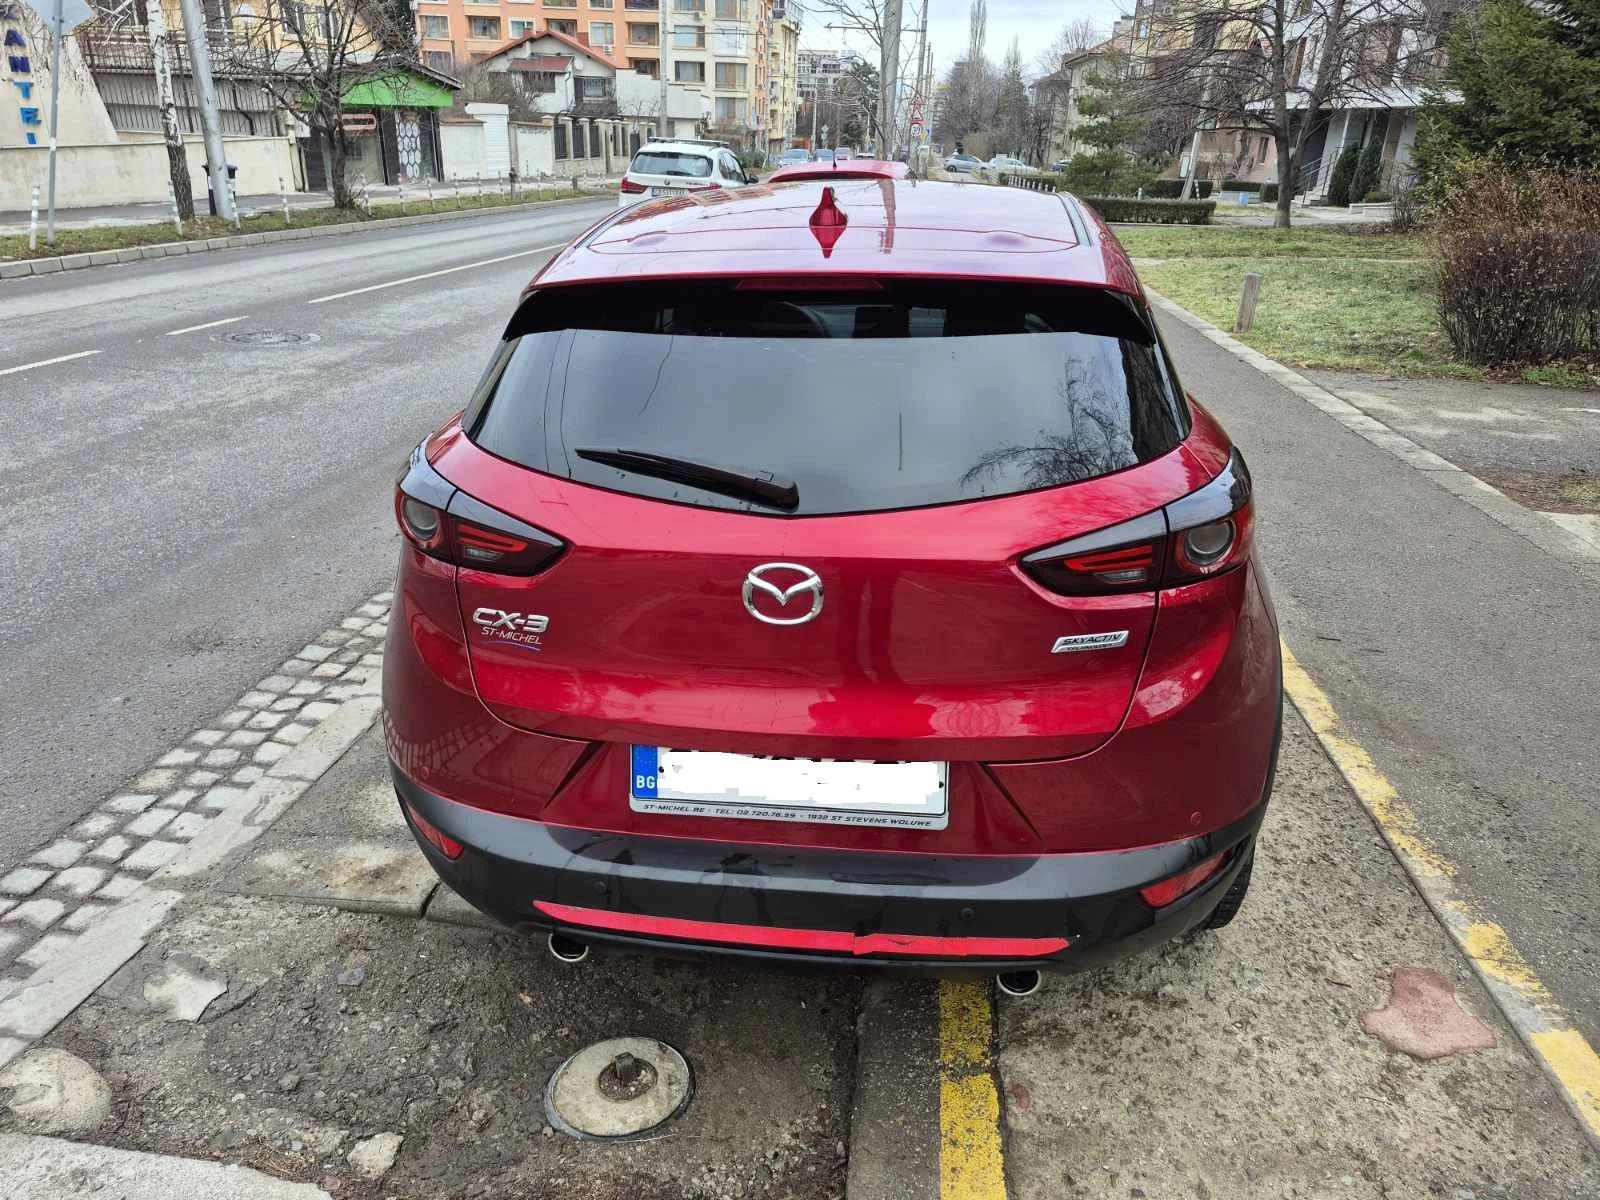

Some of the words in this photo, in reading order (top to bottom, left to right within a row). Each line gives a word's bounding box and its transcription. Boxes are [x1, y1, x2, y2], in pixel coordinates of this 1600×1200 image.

[473, 607, 550, 633] CX-3
[481, 626, 542, 645] ST-MICHEL
[1062, 632, 1122, 646] SKYACTIV
[636, 775, 656, 789] BG
[845, 816, 889, 824] STEVENS
[890, 818, 933, 827] WOLUWE
